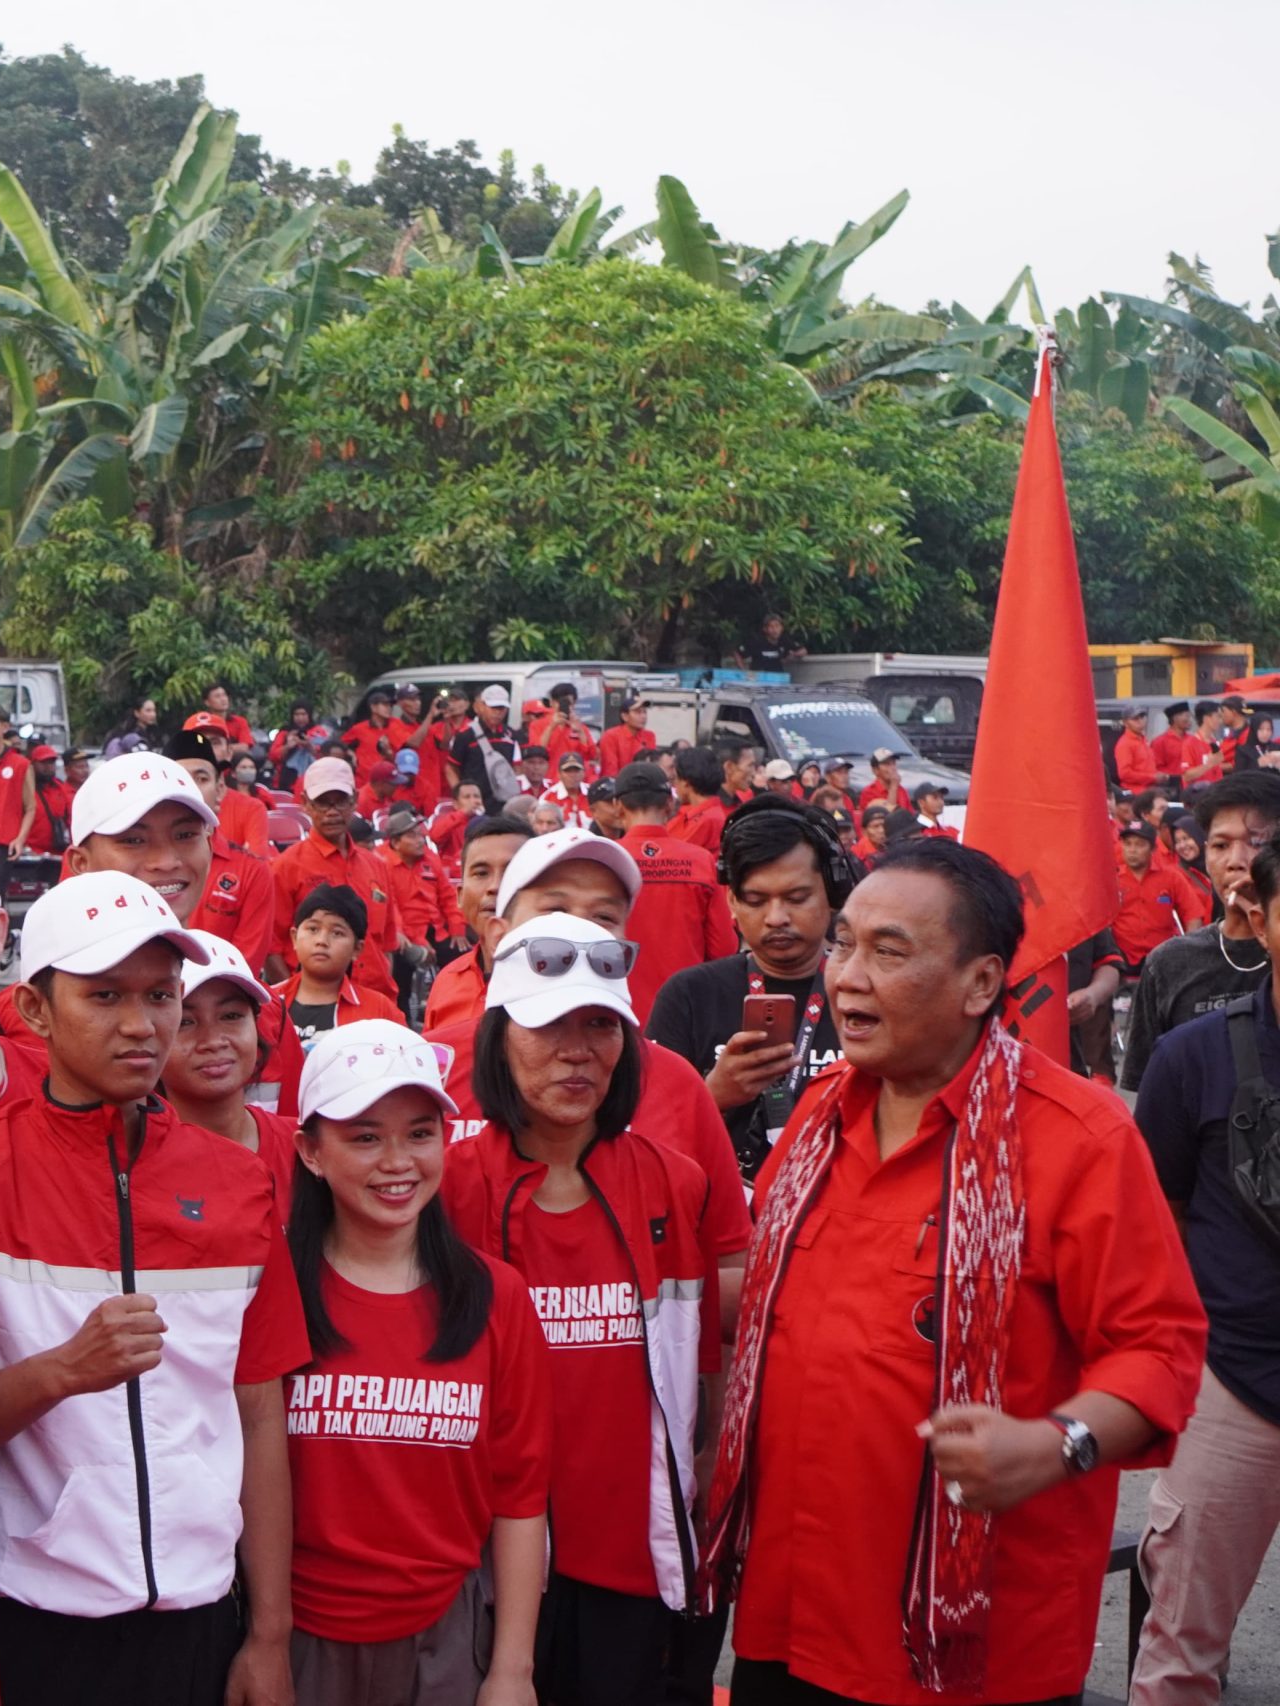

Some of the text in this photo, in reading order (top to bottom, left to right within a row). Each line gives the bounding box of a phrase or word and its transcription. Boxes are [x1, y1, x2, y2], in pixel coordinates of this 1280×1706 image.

[1194, 999, 1226, 1014] EIG
[448, 1119, 488, 1144] AP
[528, 1282, 642, 1320] ERJUANGA
[607, 1317, 644, 1341] PADA
[289, 1374, 484, 1418] API PERJUANGAN
[287, 1410, 480, 1443] NAN TAK KUNJUNG PADAM
